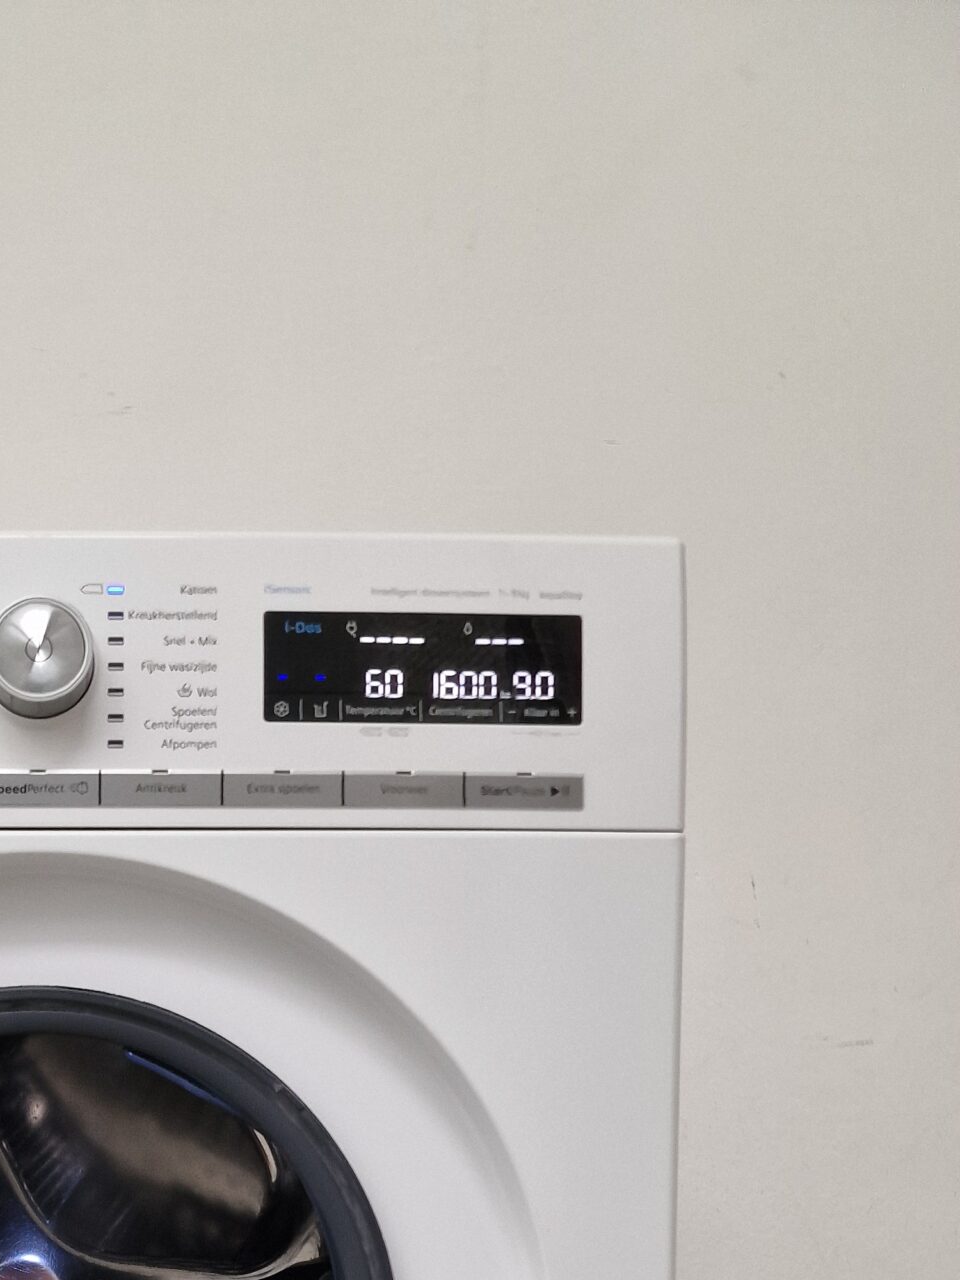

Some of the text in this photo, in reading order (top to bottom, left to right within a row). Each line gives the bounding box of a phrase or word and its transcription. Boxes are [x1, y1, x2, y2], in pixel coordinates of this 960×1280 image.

[365, 669, 404, 699] 60
[433, 670, 498, 700] 1600
[144, 719, 218, 732] Centrifugeren
[161, 738, 218, 751] Afpompen
